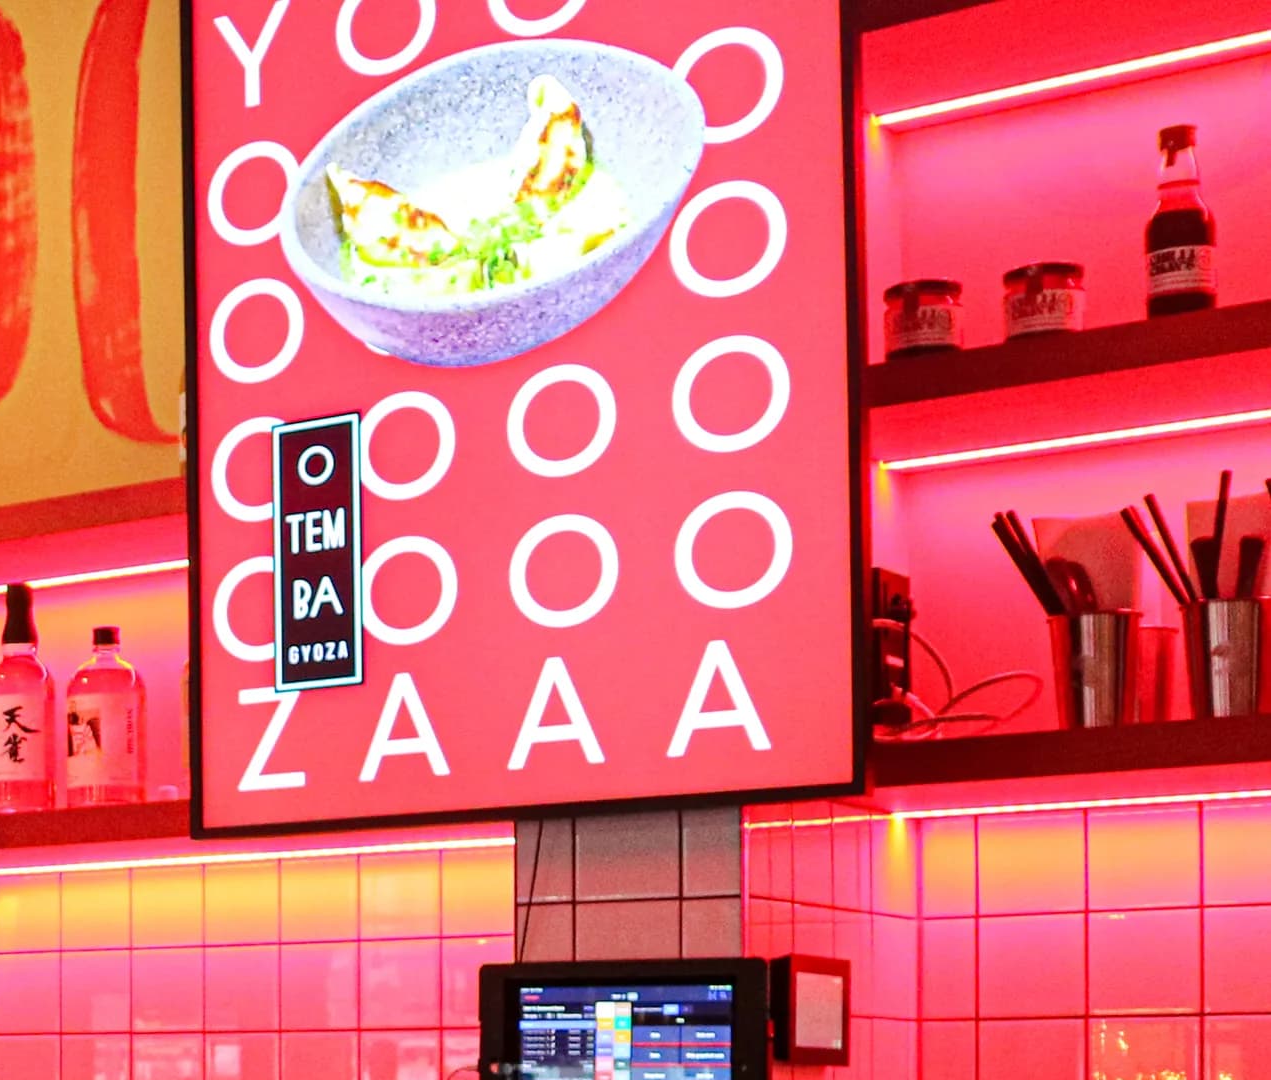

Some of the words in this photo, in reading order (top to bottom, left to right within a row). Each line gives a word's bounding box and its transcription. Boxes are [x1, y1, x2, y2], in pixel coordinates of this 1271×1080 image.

[297, 445, 335, 486] O
[285, 507, 346, 554] TEM
[292, 575, 344, 620] BA
[288, 641, 348, 664] GYOZA
[0, 705, 41, 763] 天雀
[237, 640, 772, 792] ZAAA
